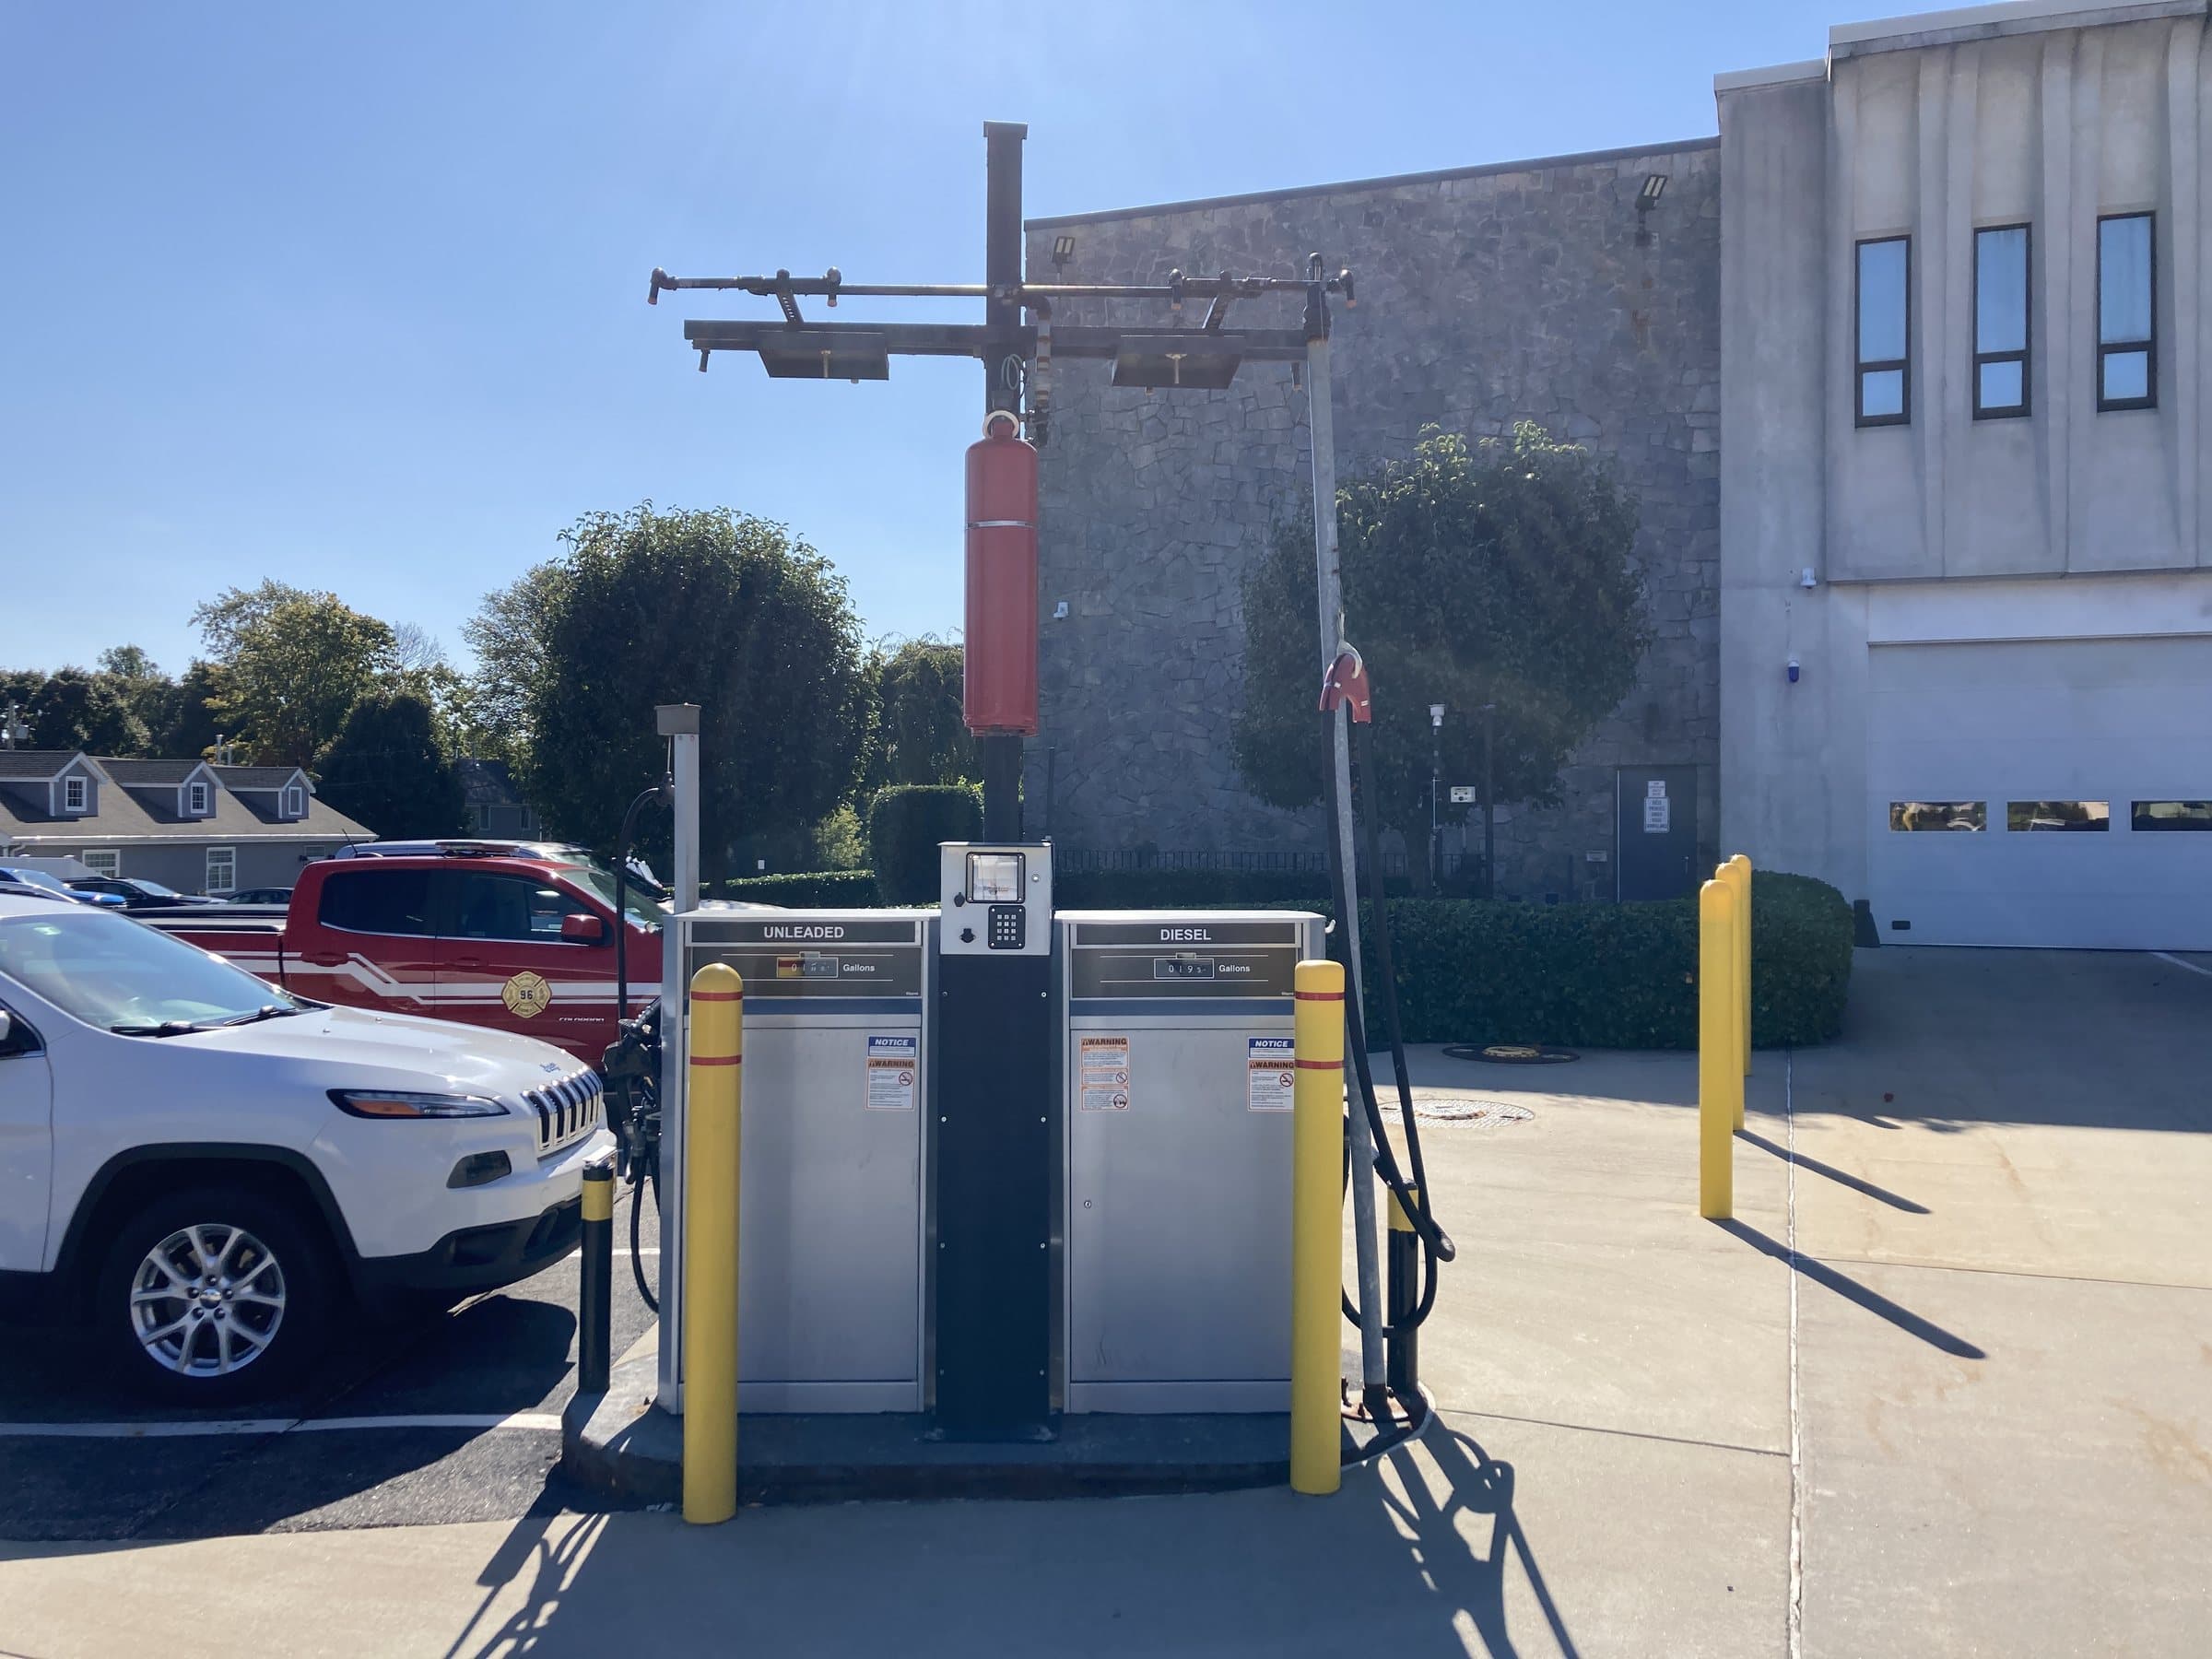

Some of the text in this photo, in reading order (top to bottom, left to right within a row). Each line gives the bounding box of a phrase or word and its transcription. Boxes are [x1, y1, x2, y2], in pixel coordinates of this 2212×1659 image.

[763, 926, 844, 938] UNLEADED
[1159, 928, 1212, 941] DIESEL
[842, 963, 876, 972] Gallons
[1218, 964, 1251, 972] Gallons
[520, 990, 534, 1000] 96
[1088, 1038, 1127, 1046] WARNING
[1254, 1040, 1288, 1048] NOTICE
[1255, 1061, 1294, 1069] WARNING
